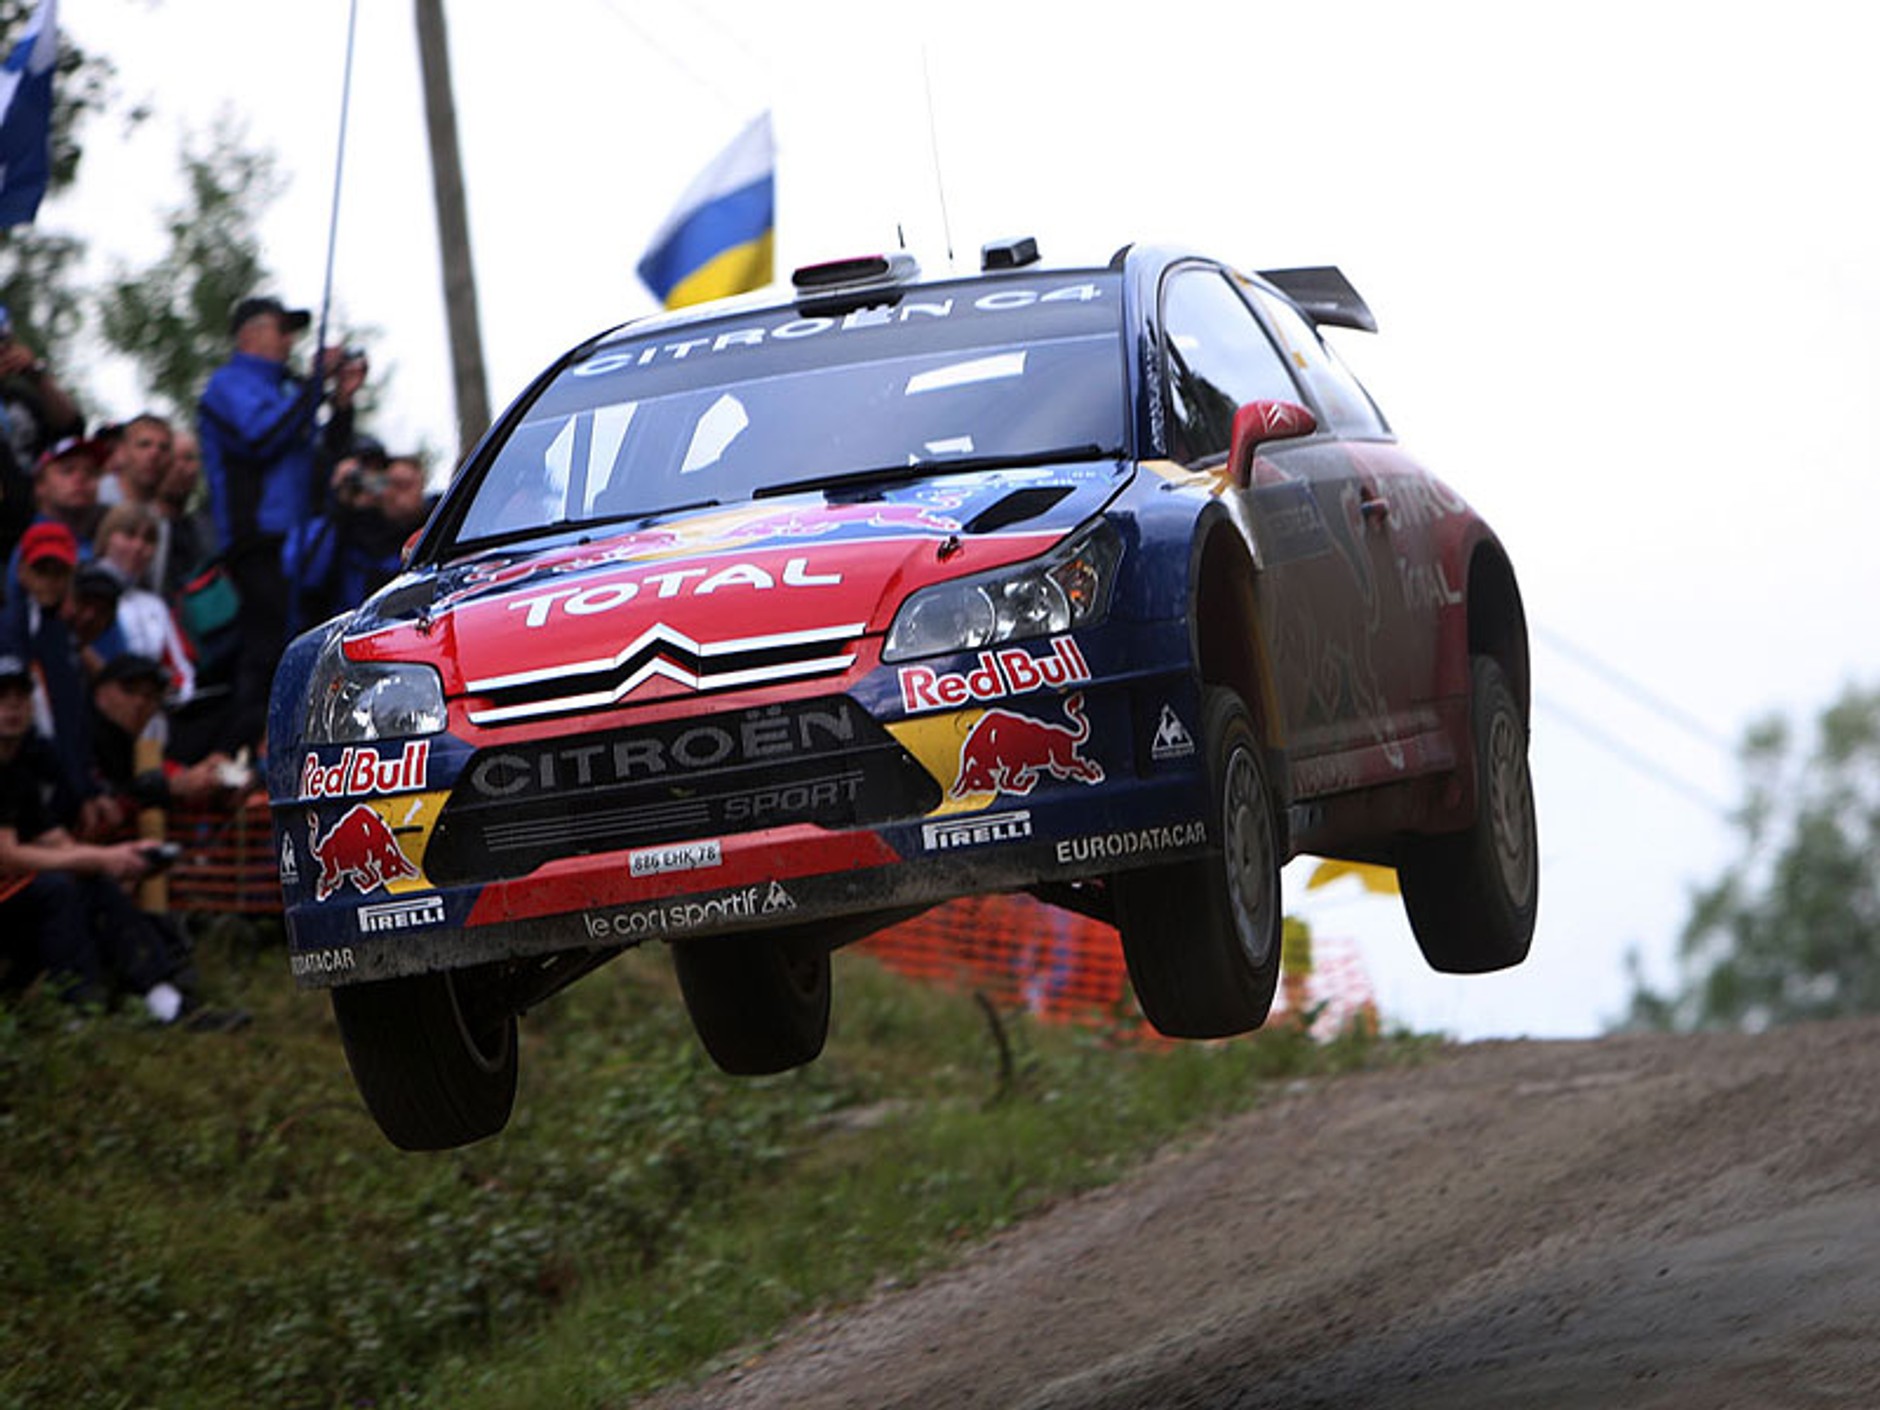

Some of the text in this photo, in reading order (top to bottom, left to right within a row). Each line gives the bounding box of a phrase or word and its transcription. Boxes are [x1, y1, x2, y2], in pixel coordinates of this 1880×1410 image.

[974, 283, 1101, 312] C4
[508, 557, 843, 627] TOTAL
[898, 635, 1092, 714] Red Bull
[300, 740, 431, 800] Red Bull
[471, 702, 855, 797] CITROËN
[724, 776, 865, 820] SPORT
[922, 810, 1032, 850] PIRELLI
[1056, 822, 1208, 864] EURODATACAR
[357, 896, 446, 932] PIRELLI
[583, 912, 610, 938] le
[670, 888, 757, 926] sportif
